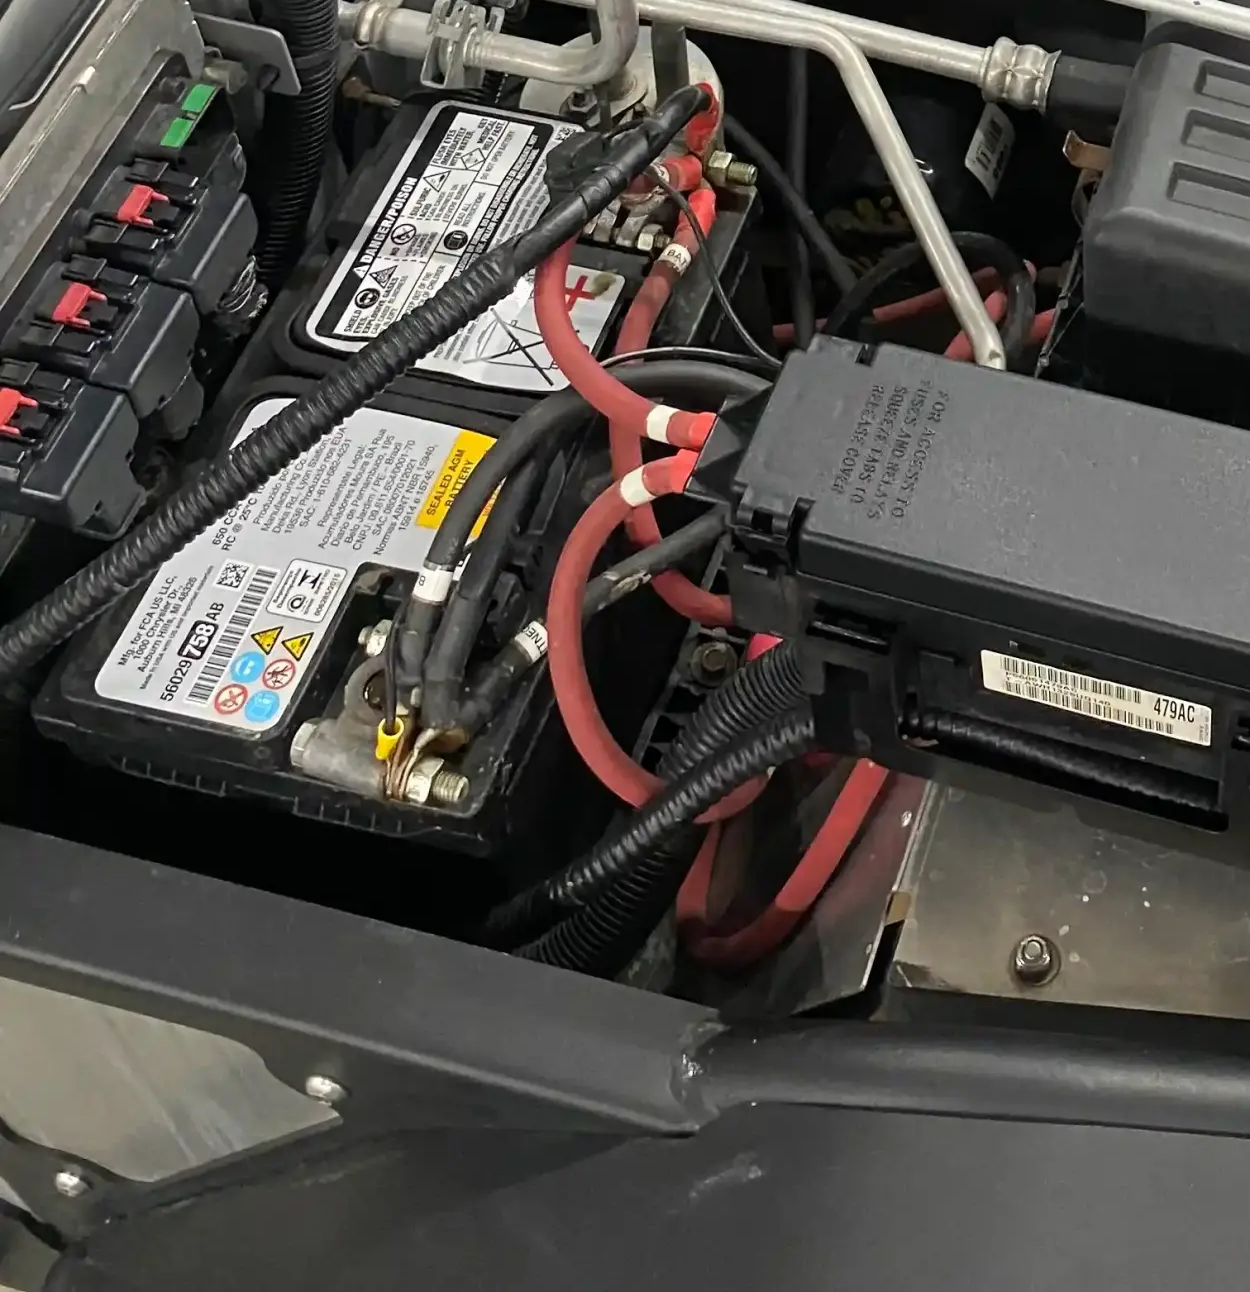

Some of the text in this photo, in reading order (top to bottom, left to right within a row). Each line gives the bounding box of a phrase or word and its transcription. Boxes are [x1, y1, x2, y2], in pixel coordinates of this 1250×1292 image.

[432, 128, 457, 164] FLUSH EYES
[440, 126, 467, 166] IMMEDIATELY
[476, 117, 488, 129] GET
[481, 135, 495, 151] HELP
[448, 150, 462, 167] WITH
[359, 175, 418, 264] DANGER/POISON
[409, 186, 431, 216] SULFURIC
[342, 308, 362, 332] SHIELD
[361, 298, 386, 334] EXPLOSIVE
[298, 463, 327, 506] Produzido
[330, 426, 348, 446] EUA
[829, 383, 885, 495] RELEASE COVER
[848, 384, 909, 504] SQUEEZE TABS TO
[865, 379, 932, 520] FUSES AND RELAYS
[890, 389, 949, 518] FOR ACCESS TO
[252, 482, 282, 524] Produzido
[260, 472, 301, 532] Manufacturing
[271, 510, 291, 534] Deka
[295, 469, 313, 491] Lyon
[316, 428, 387, 549] Acumuladores Moura SA Rua
[342, 522, 361, 544] Belo
[354, 492, 376, 522] Jardim
[371, 472, 386, 487] PE
[383, 441, 403, 465] Brazil
[425, 447, 466, 516] SEALED AGM
[442, 459, 474, 506] BATTERY
[211, 526, 228, 545] 650
[220, 534, 236, 551] RC
[370, 514, 388, 536] SAC
[372, 520, 398, 556] Normas
[390, 494, 410, 520] ABNT
[404, 472, 422, 494] NBR
[117, 646, 136, 666] Mfg.
[129, 630, 143, 645] for
[137, 610, 156, 630] FCA
[149, 595, 164, 610] US
[132, 638, 150, 660] 1000
[144, 599, 173, 638] Chrysler
[136, 576, 198, 672] Auburn Hills, MI 48326
[1152, 696, 1195, 723] 479AC
